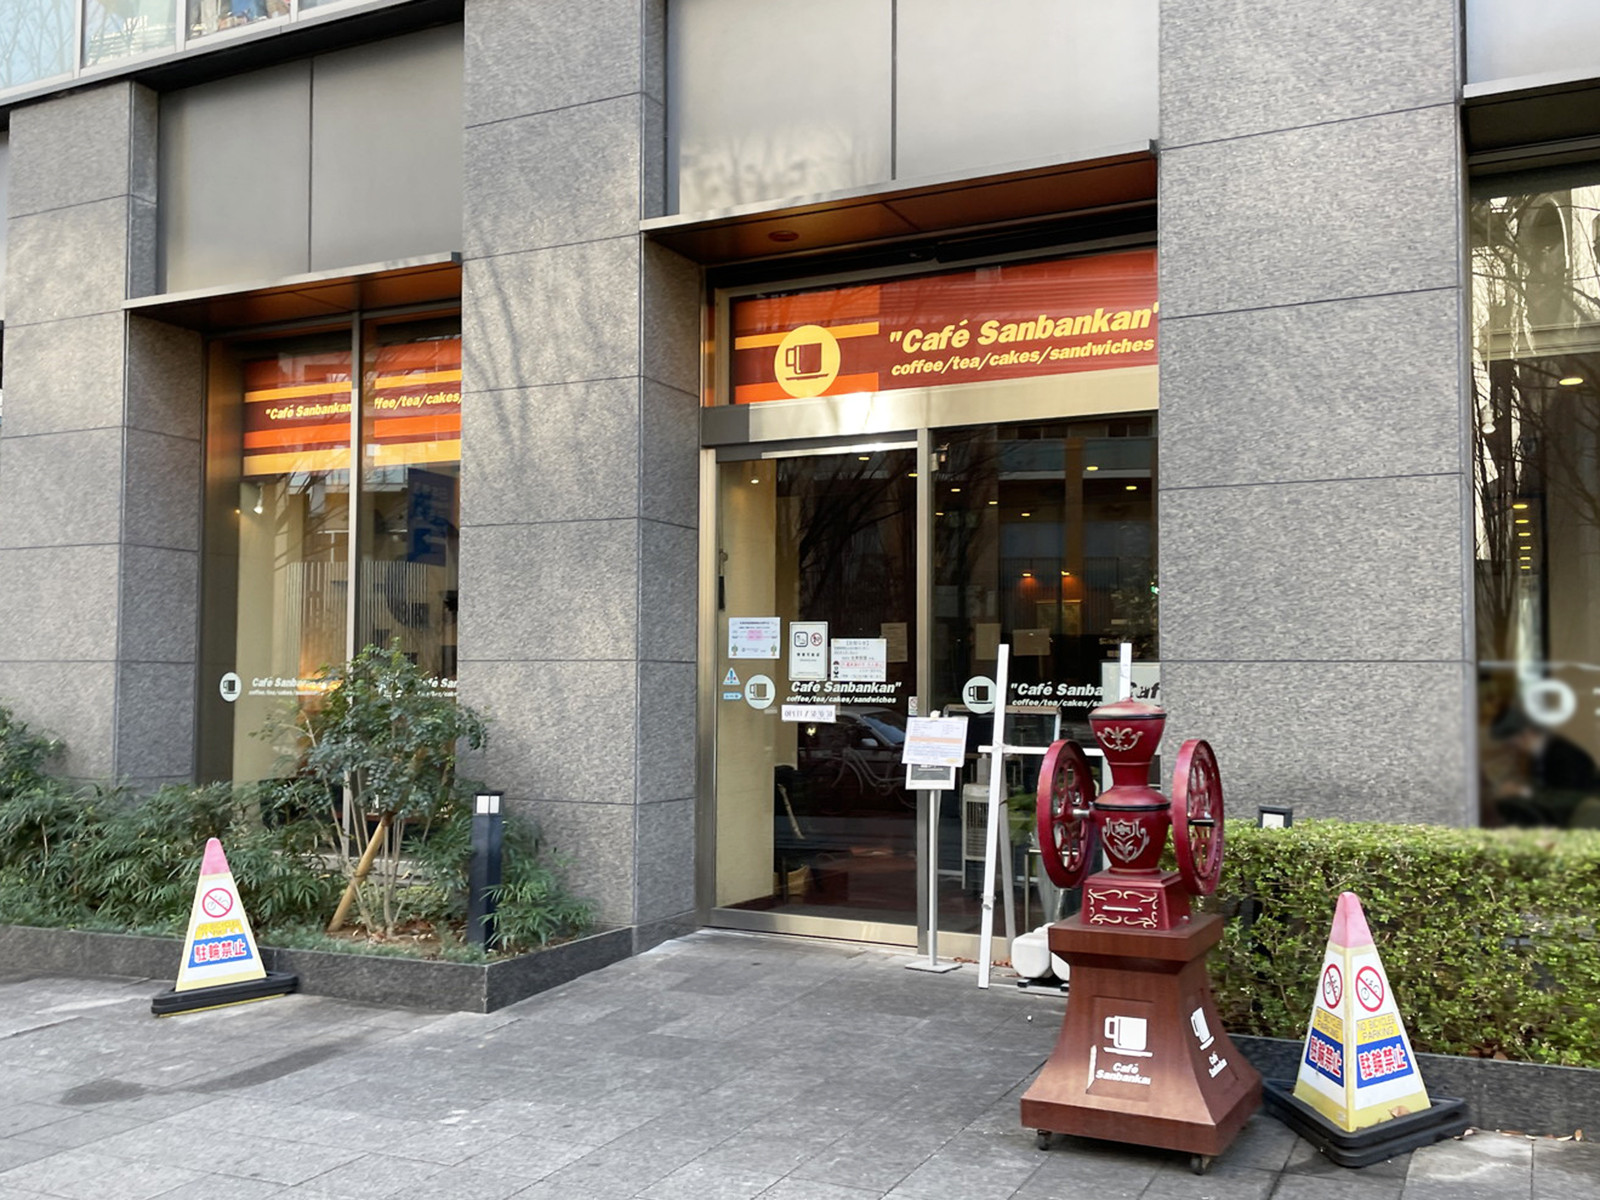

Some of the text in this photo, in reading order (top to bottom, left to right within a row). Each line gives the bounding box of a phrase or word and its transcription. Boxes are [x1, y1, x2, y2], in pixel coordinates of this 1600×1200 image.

[889, 320, 969, 354] "Café
[891, 338, 1154, 376] coffee/tea/cakes/sandwiches
[824, 681, 902, 693] Sanbankan"
[1010, 682, 1052, 696] "Café
[194, 939, 247, 963] 駐輪禁止
[1112, 1062, 1139, 1074] Café
[1359, 1044, 1408, 1080] 駐輪禁止
